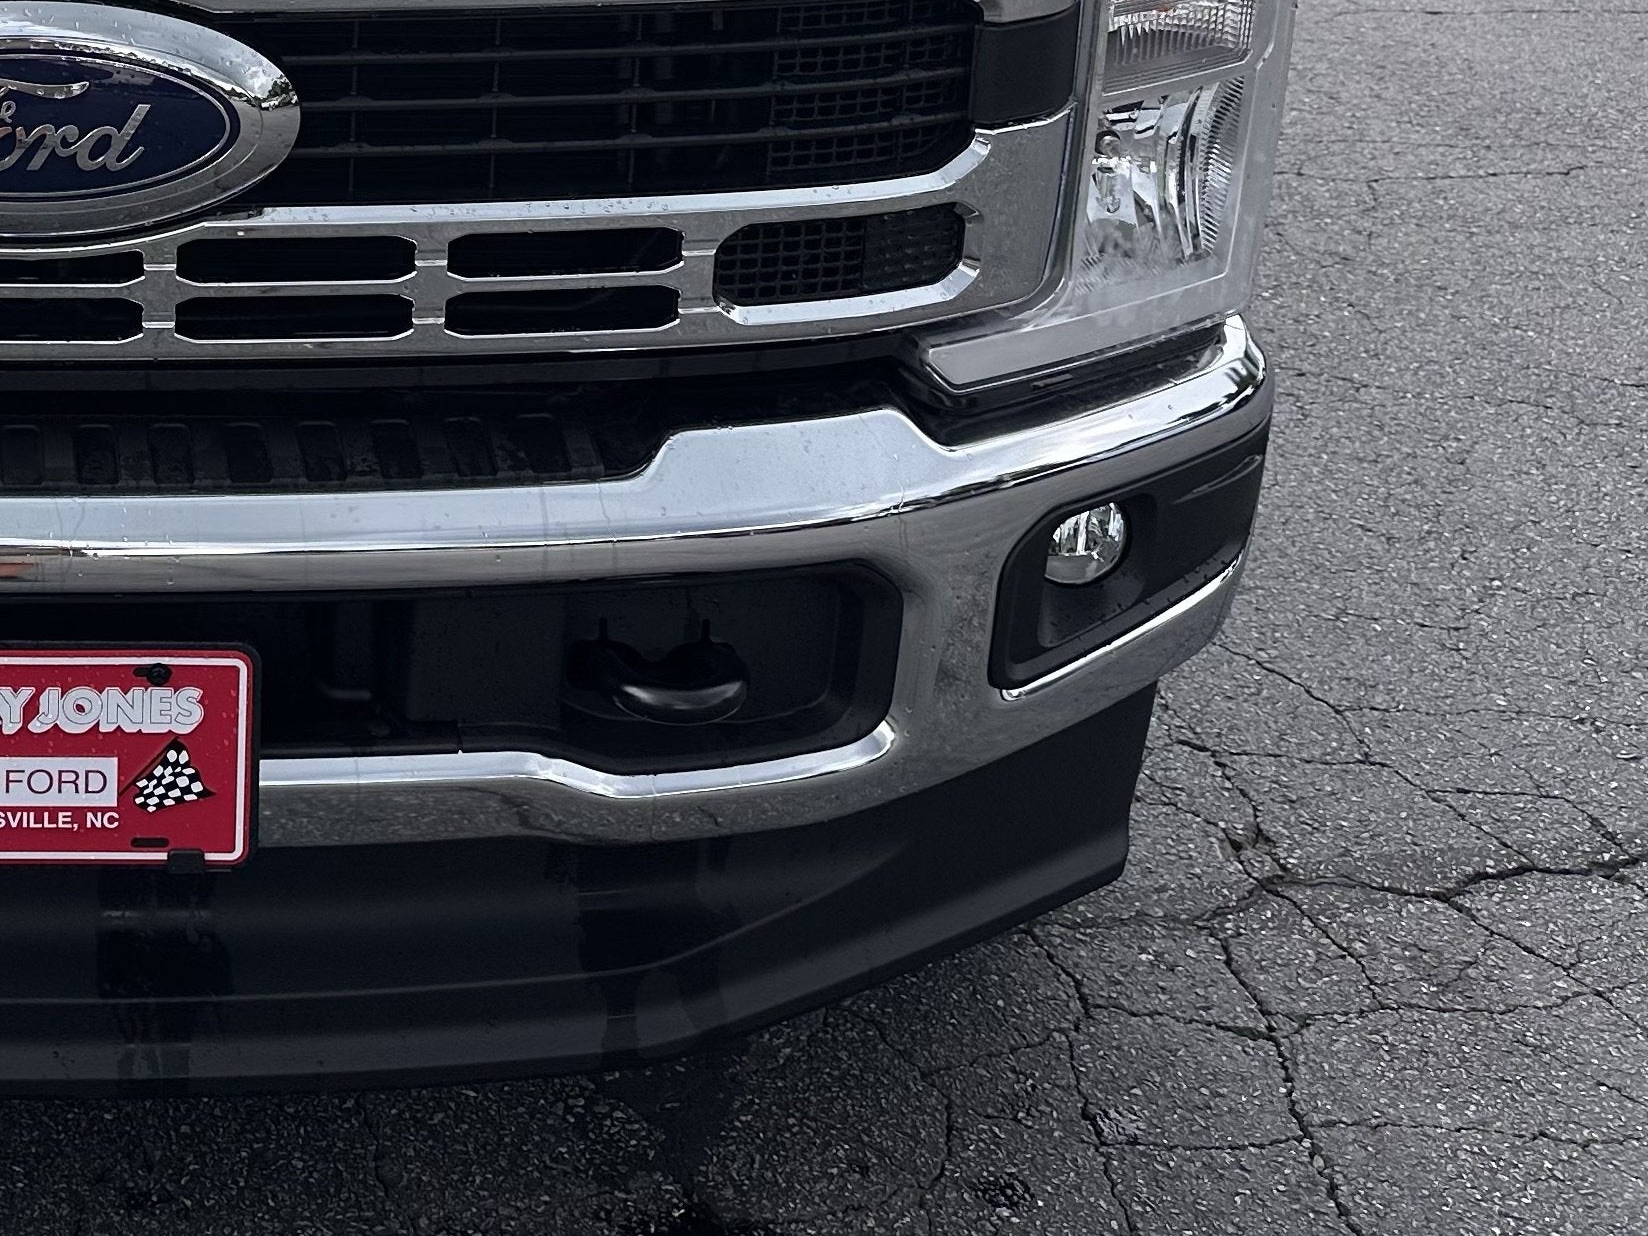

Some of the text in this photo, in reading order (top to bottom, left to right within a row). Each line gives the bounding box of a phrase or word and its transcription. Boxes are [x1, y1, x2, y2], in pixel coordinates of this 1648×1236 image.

[27, 686, 204, 735] JONES
[4, 768, 108, 795] FORD
[85, 811, 120, 829] NC
